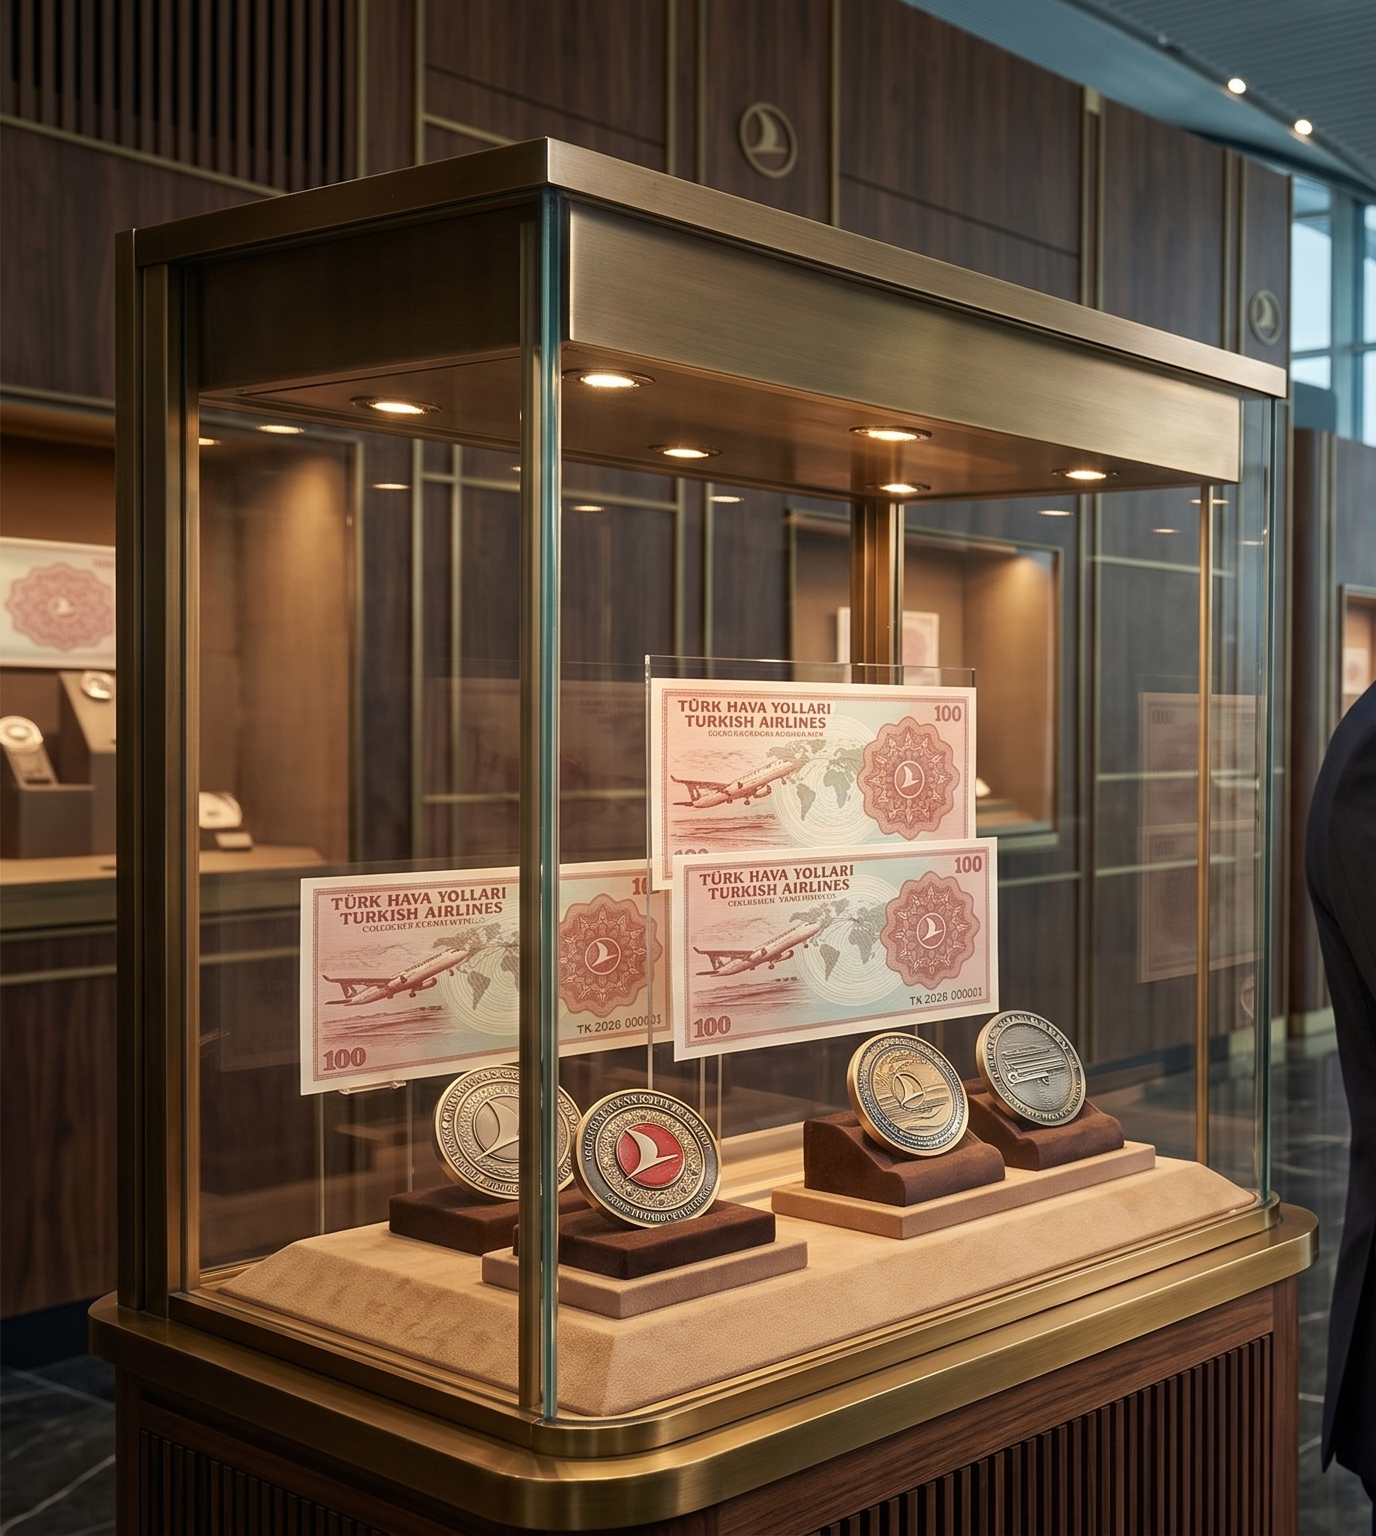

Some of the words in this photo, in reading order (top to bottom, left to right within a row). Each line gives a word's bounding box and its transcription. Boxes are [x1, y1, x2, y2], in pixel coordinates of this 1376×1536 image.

[678, 698, 722, 713] TÜRK
[727, 701, 767, 714] HAVA
[771, 702, 831, 715] YOLLARI
[934, 705, 962, 722] 100
[685, 715, 754, 728] TURKISH
[759, 716, 827, 729] AIRLINES
[954, 855, 983, 874] 100
[699, 870, 745, 886] TÜRK
[749, 868, 789, 883] HAVA
[793, 864, 854, 880] YOLLARI
[331, 894, 382, 911] TÜRK
[387, 892, 432, 908] HAVA
[437, 886, 507, 904] YOLLARI
[708, 883, 777, 900] TURKISH
[781, 878, 850, 895] AIRLINES
[339, 907, 419, 925] TURKISH
[424, 901, 503, 919] AIRLINES
[924, 992, 948, 1004] 2026
[951, 987, 982, 1000] 000001
[576, 1024, 592, 1034] TK
[594, 1019, 621, 1033] 2026
[693, 1015, 731, 1039] 100
[322, 1047, 367, 1072] 100
